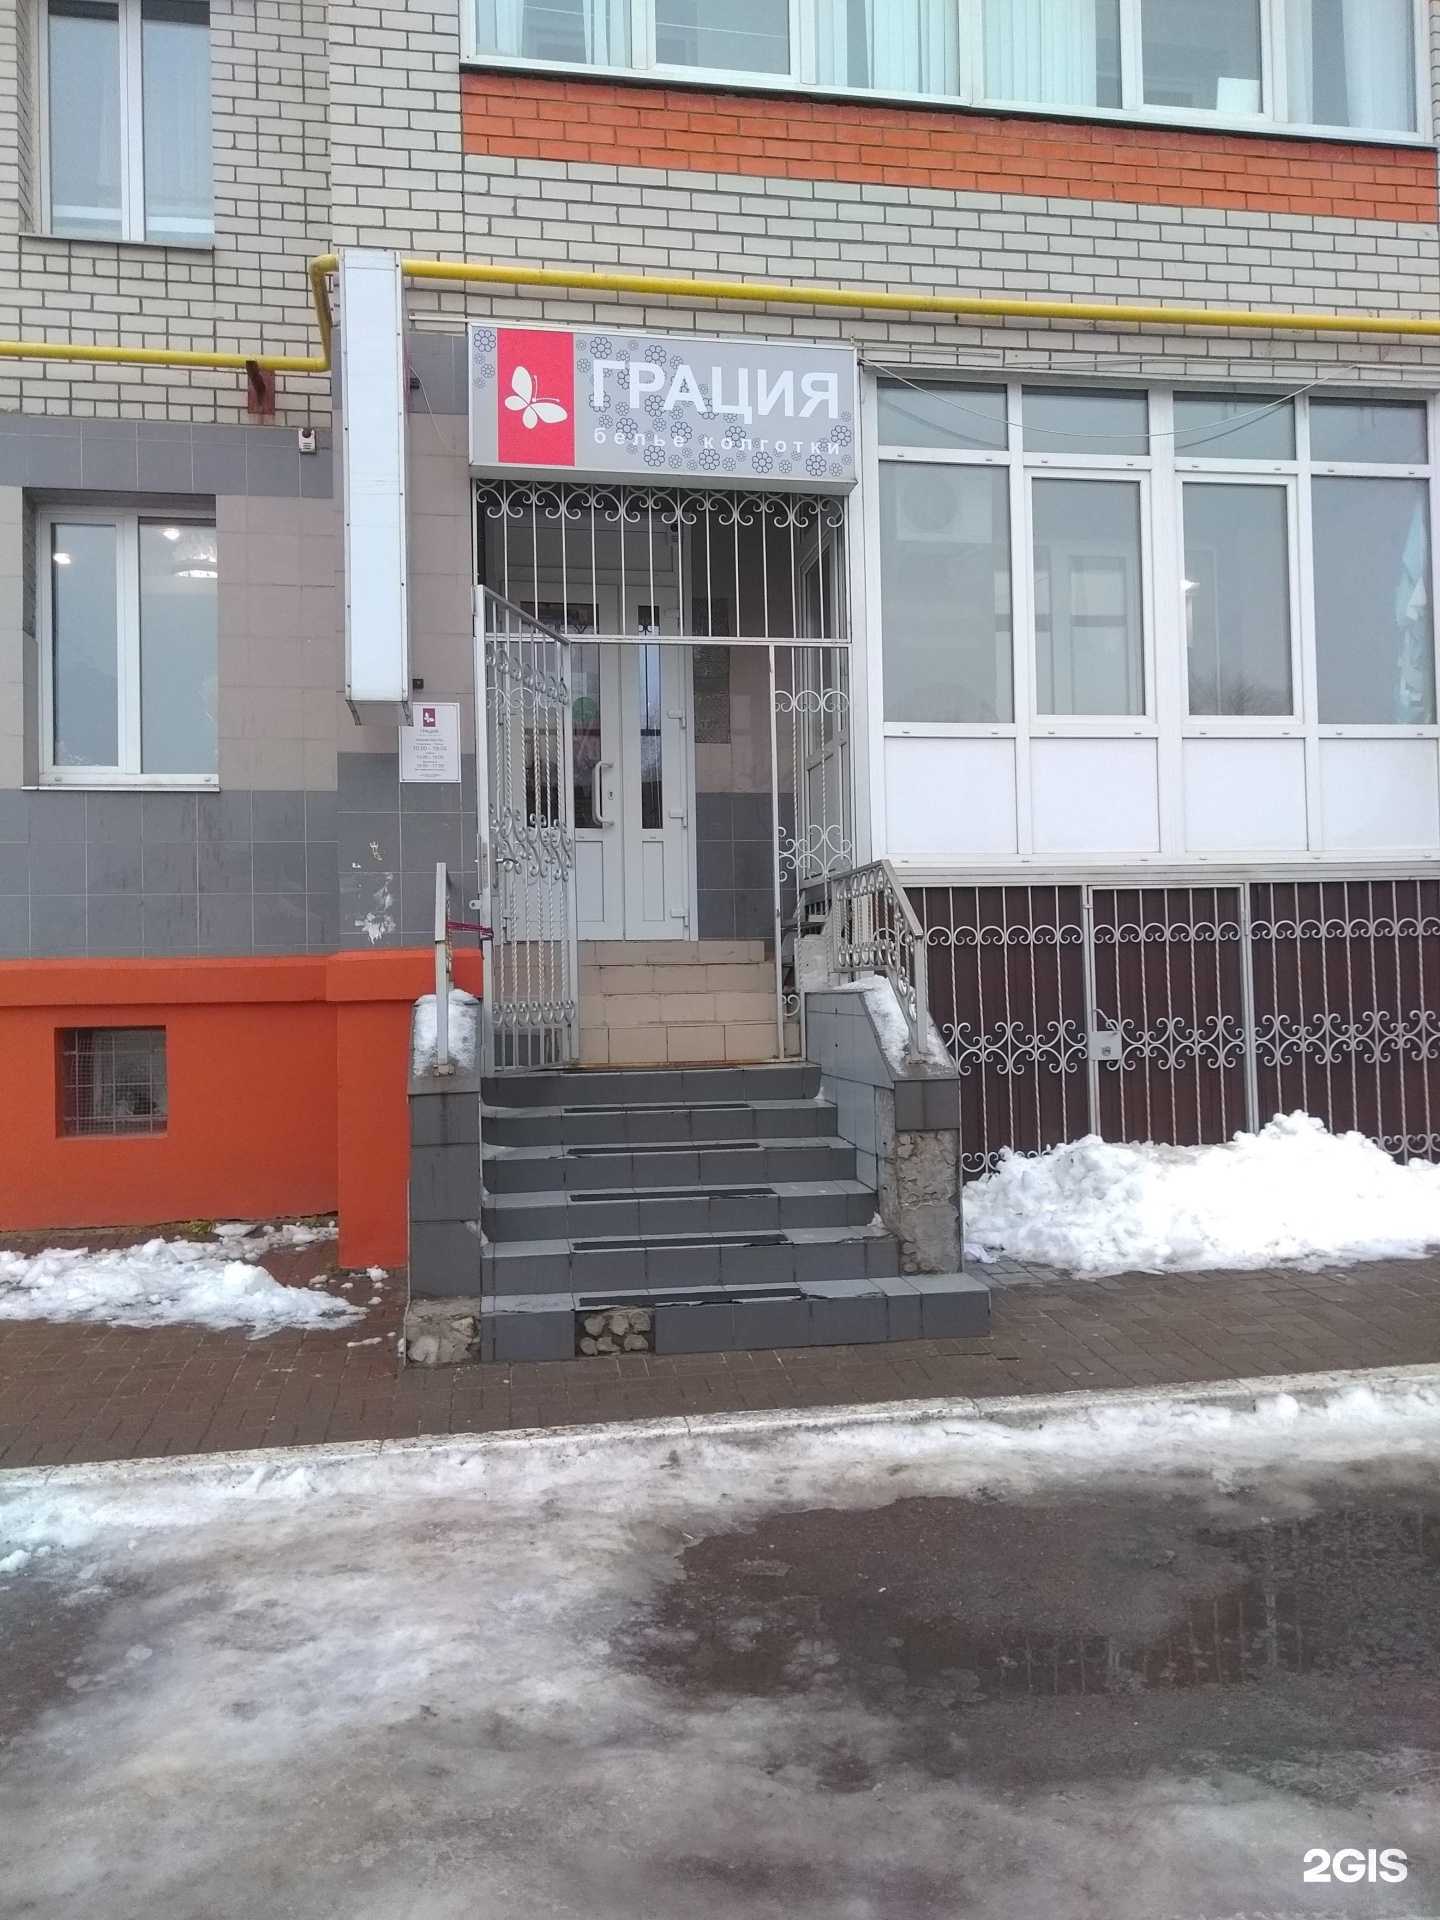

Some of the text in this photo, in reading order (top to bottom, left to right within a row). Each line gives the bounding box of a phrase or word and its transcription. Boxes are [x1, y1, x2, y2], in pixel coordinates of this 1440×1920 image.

[592, 359, 839, 425] ГРАЦИЯ
[593, 426, 840, 456] белье колготки
